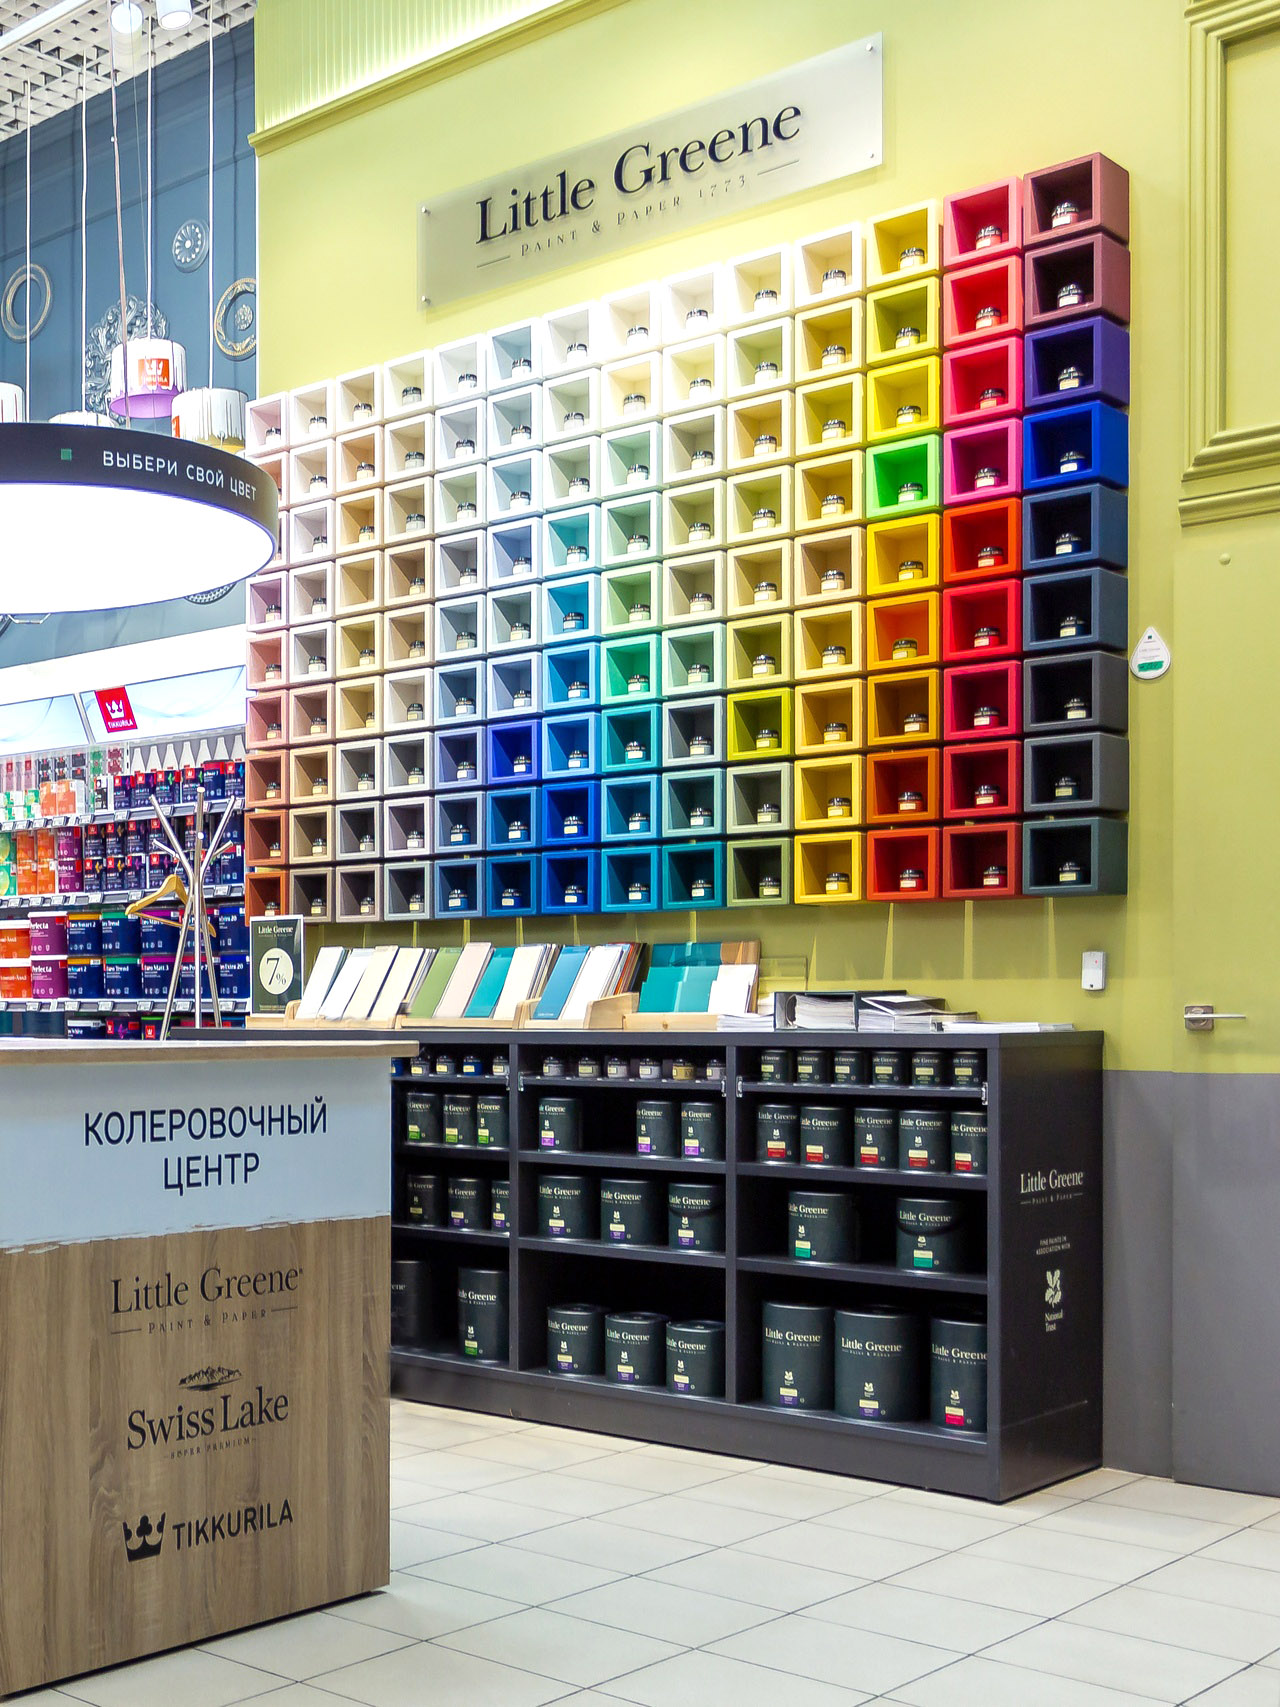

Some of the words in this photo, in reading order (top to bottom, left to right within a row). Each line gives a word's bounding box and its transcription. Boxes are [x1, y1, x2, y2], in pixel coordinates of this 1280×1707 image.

[475, 169, 595, 245] Little
[614, 105, 802, 195] Greene
[521, 228, 578, 257] PAINT
[592, 219, 602, 234] &
[617, 195, 681, 226] PAPER
[103, 451, 178, 476] ВЫБЕРИ
[186, 464, 224, 488] СВОЙ
[231, 476, 256, 501] ЦВЕТ
[108, 720, 133, 729] TIKKURILA
[258, 926, 272, 934] Little
[273, 925, 293, 934] Greene
[266, 958, 286, 985] 7%
[84, 1095, 328, 1146] КОЛЕРОВОЧНЫЙ
[758, 1112, 772, 1120] Little
[774, 1112, 797, 1121] Greene
[812, 1118, 839, 1127] Greene
[865, 1117, 892, 1125] Greene
[900, 1117, 914, 1126] Little
[916, 1118, 943, 1127] Greene
[960, 1124, 988, 1133] Greene
[164, 1152, 260, 1196] ЦЕНТР
[1020, 1170, 1047, 1193] Little
[1049, 1169, 1084, 1189] Greene
[454, 1188, 476, 1196] Greene
[539, 1185, 552, 1195] Little
[554, 1187, 581, 1196] Greene
[614, 1192, 641, 1201] Greene
[682, 1197, 710, 1205] Greene
[799, 1204, 829, 1215] Greene
[899, 1211, 917, 1221] Little
[919, 1212, 951, 1222] Greene
[1040, 1237, 1048, 1246] FINE
[1049, 1237, 1062, 1245] PAINTS
[1036, 1244, 1060, 1255] ASSOCIATION
[1061, 1243, 1070, 1251] WITH
[111, 1273, 189, 1314] Little
[468, 1291, 496, 1301] Greene
[148, 1319, 193, 1334] PAINT
[204, 1315, 211, 1327] &
[223, 1309, 266, 1324] PAPER
[1045, 1309, 1063, 1322] National
[548, 1319, 560, 1331] Little
[561, 1322, 588, 1332] Greene
[1045, 1323, 1056, 1332] Trust
[606, 1328, 620, 1341] Little
[622, 1331, 649, 1342] Greene
[765, 1327, 783, 1340] Little
[786, 1331, 820, 1342] Greene
[678, 1340, 706, 1351] Greene
[841, 1337, 863, 1350] Little
[865, 1340, 902, 1352] Greene
[931, 1343, 949, 1357] Little
[951, 1347, 987, 1360] Greene
[127, 1405, 215, 1451] Swiss
[220, 1386, 288, 1432] Lake
[207, 1436, 250, 1453] PREMIUM
[172, 1499, 293, 1550] TIKKURILA
